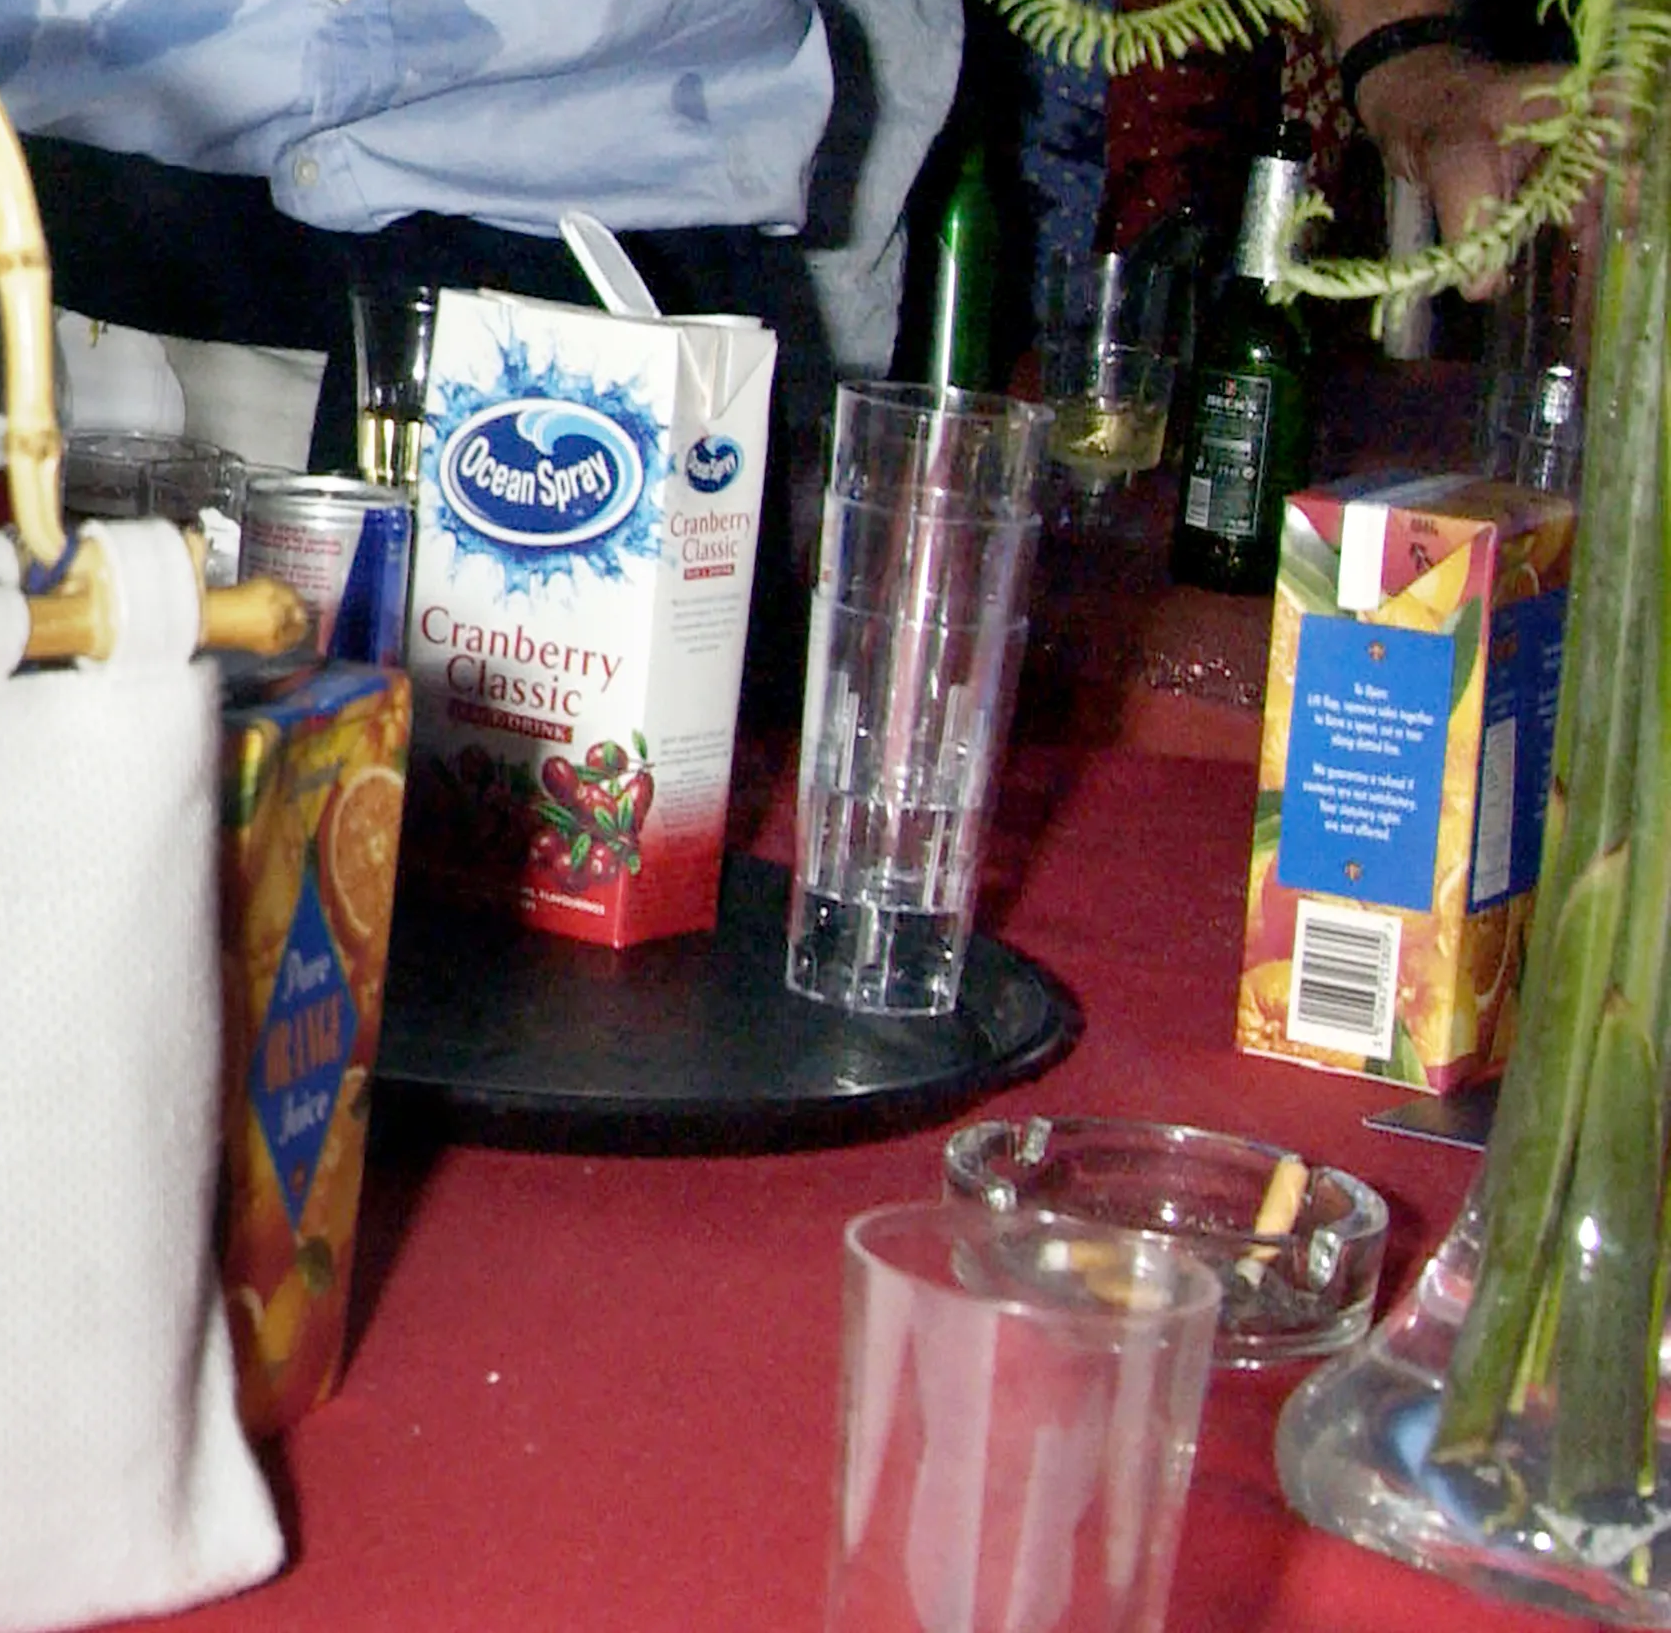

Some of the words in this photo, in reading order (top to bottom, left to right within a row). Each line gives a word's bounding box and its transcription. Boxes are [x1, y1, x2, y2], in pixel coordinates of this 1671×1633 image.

[459, 435, 536, 506] Ocean
[537, 450, 612, 513] Spray
[670, 509, 751, 539] Cranberry
[682, 536, 739, 564] Classic
[420, 605, 625, 694] Cranberry
[446, 653, 584, 717] Classic
[281, 948, 332, 1003] Pure
[265, 989, 343, 1097] ORANGE
[277, 1088, 331, 1146] Juice
